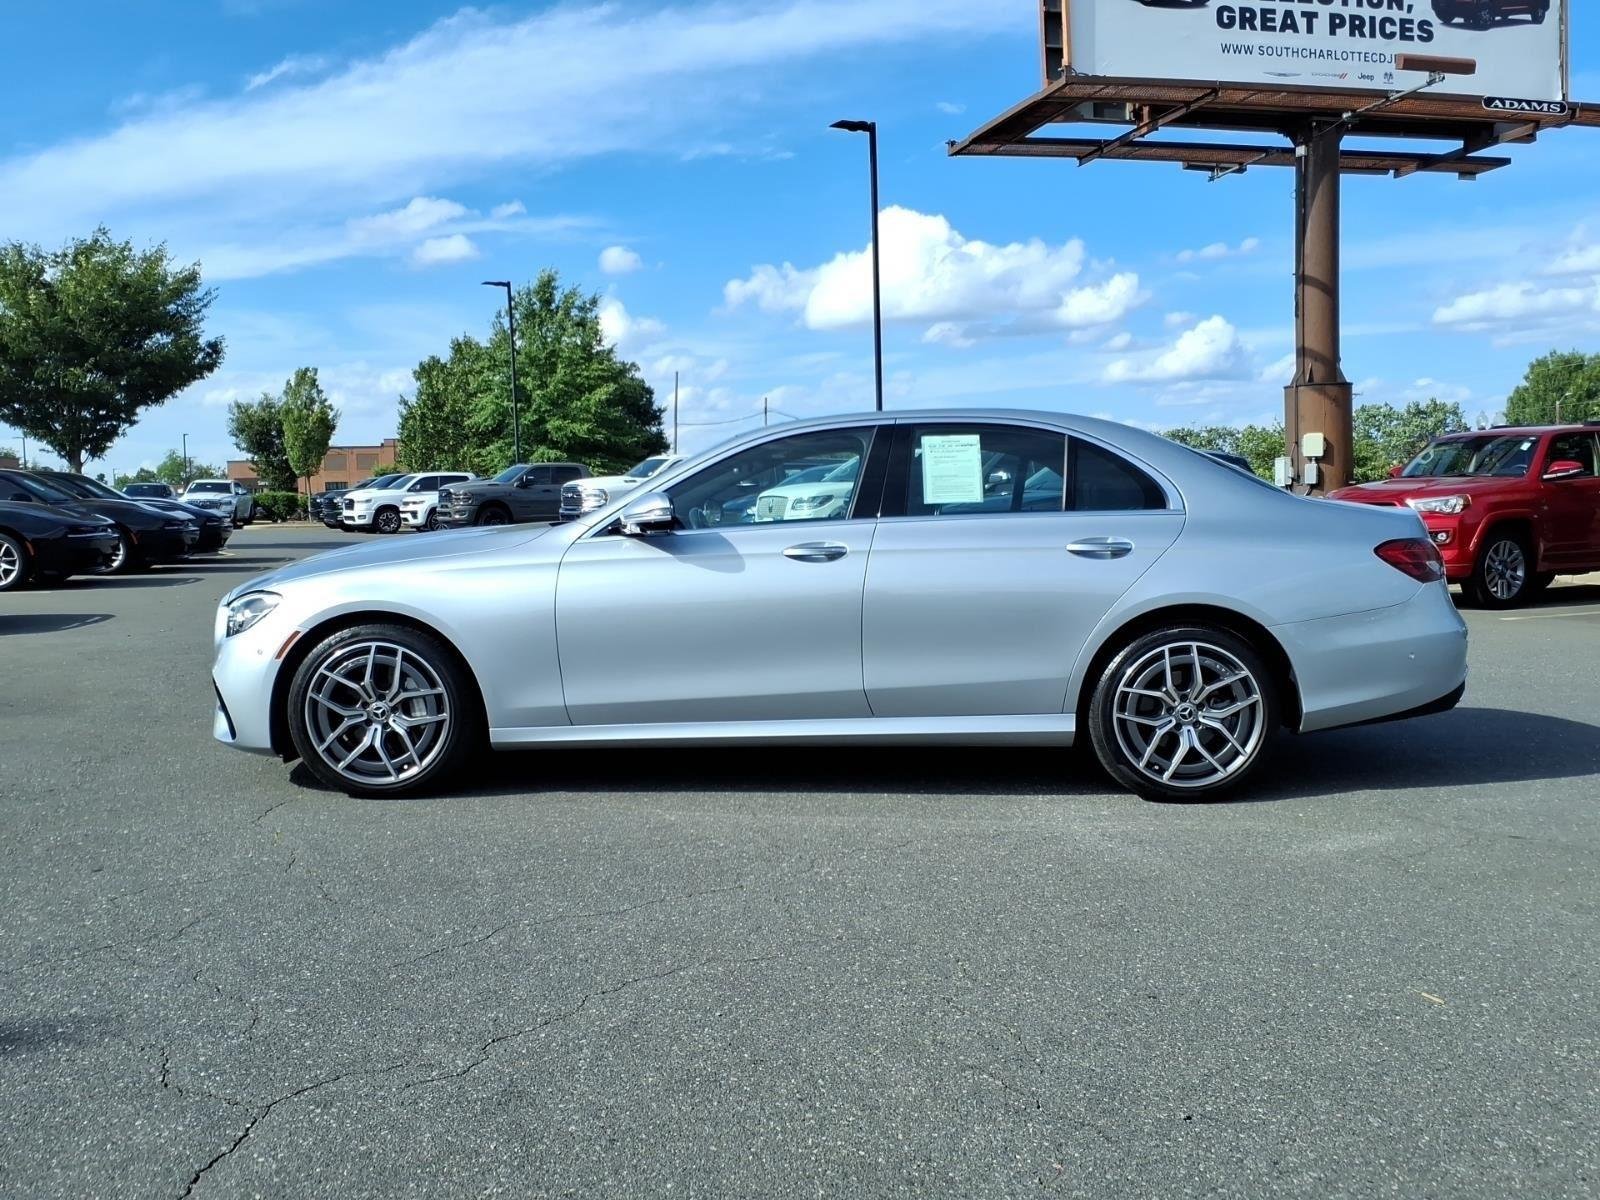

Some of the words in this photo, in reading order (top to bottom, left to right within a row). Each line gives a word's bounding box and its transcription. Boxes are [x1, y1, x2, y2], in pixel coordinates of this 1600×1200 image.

[1216, 5, 1319, 35] GREAT
[1328, 12, 1434, 43] PRICES
[1258, 45, 1397, 64] SOUTHCHARLOTTECDJ
[1357, 72, 1375, 82] Jeep
[1490, 99, 1561, 113] ADAMS
